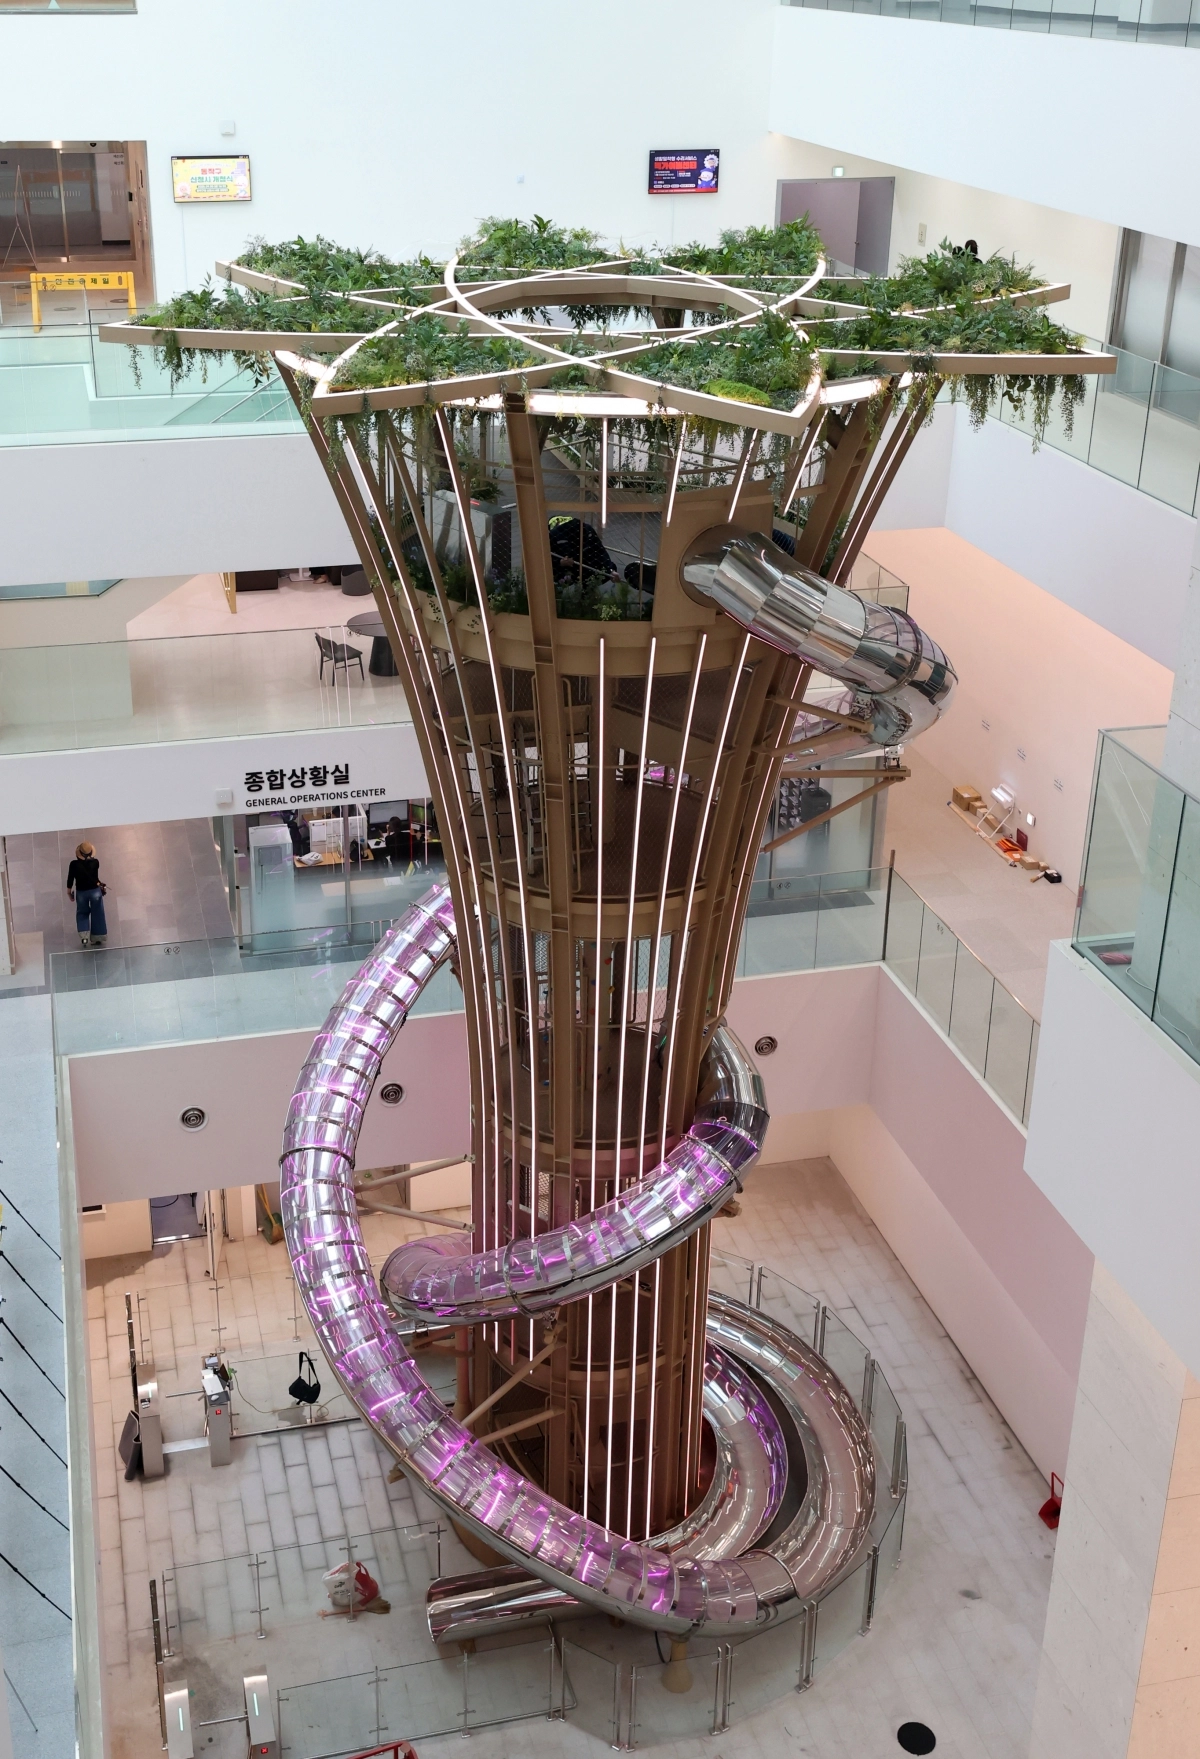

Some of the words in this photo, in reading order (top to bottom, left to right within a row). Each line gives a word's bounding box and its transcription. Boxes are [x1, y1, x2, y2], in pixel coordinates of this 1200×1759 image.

[244, 763, 350, 793] 종합상황실
[245, 796, 288, 808] GENERAL
[290, 791, 349, 804] OPERATIONS
[350, 787, 386, 798] CENTER
